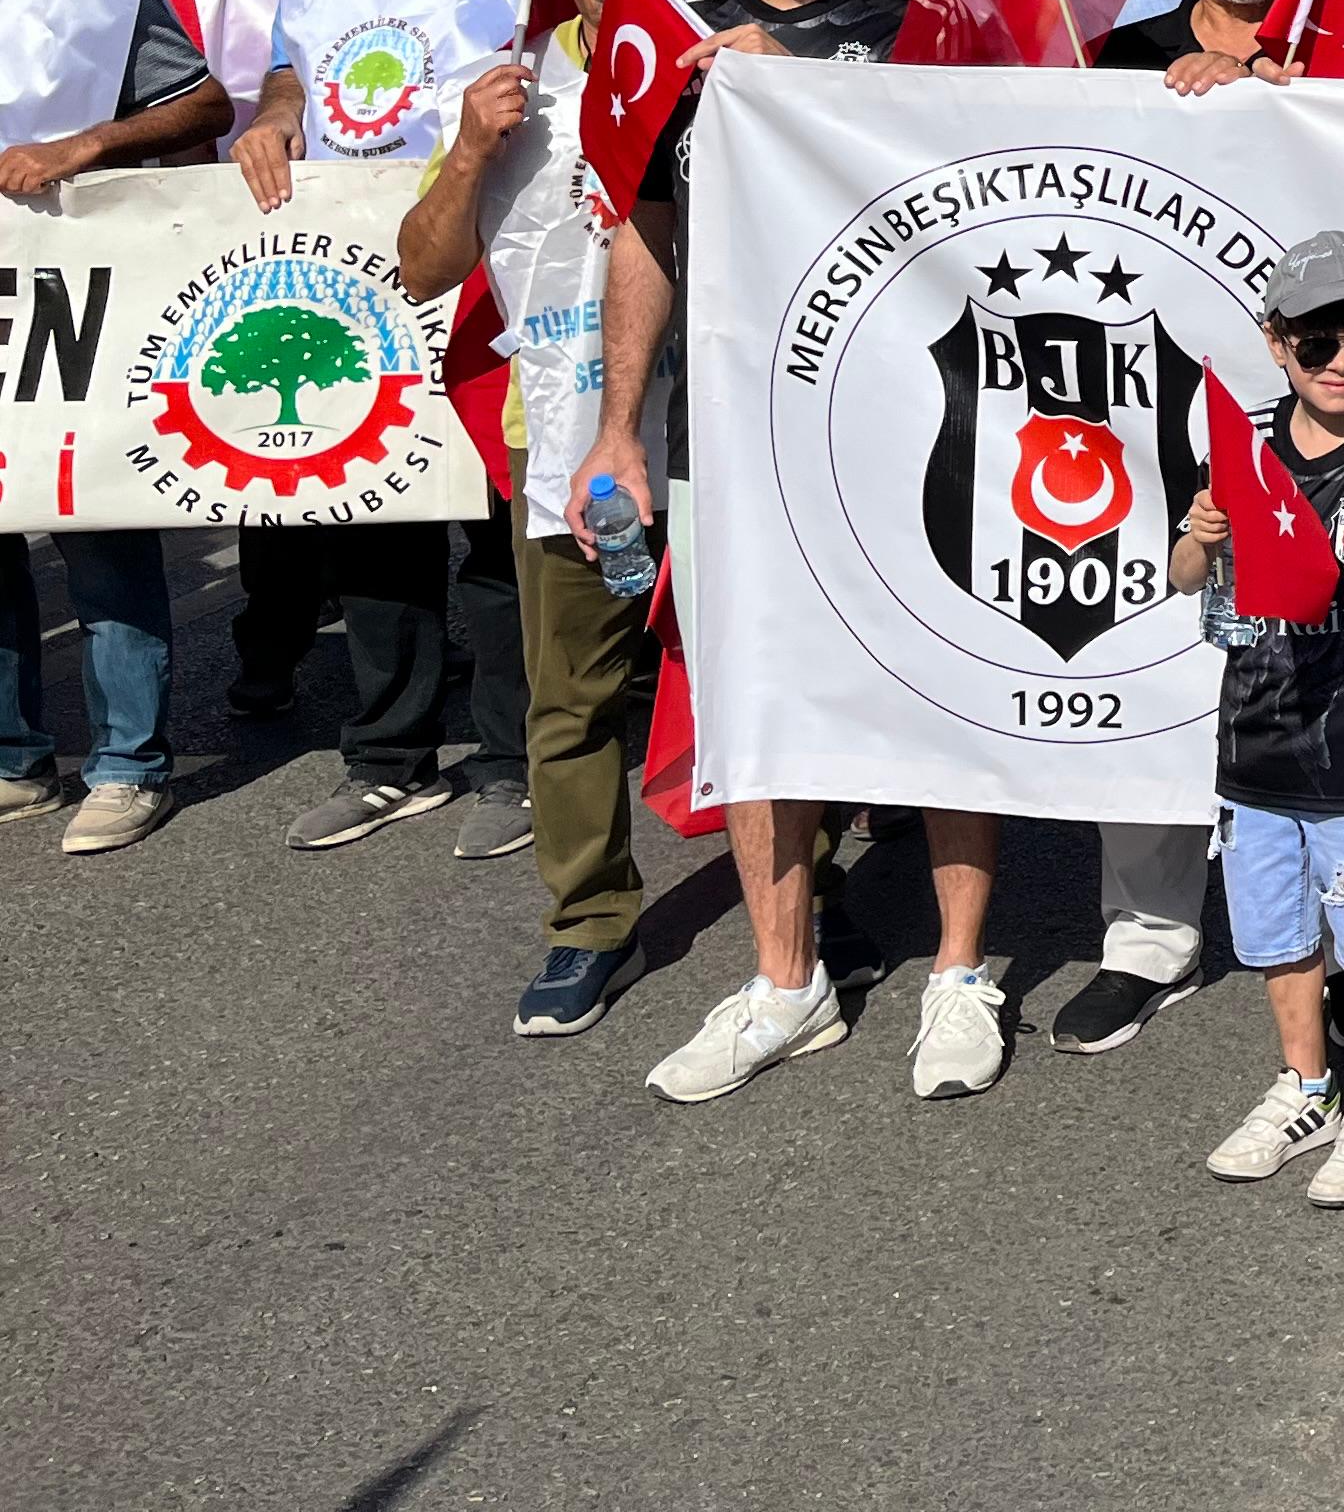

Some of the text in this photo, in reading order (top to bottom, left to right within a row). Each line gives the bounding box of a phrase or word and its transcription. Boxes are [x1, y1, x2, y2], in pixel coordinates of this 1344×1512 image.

[314, 53, 334, 84] TÜM
[332, 14, 407, 52] EMEKLİLER
[127, 332, 168, 408] TÜM
[160, 231, 333, 326] EMEKLİLER
[980, 326, 1154, 410] BJK
[257, 430, 314, 448] 2017
[125, 444, 283, 528] MERSİN
[989, 555, 1157, 607] 1903
[1010, 688, 1124, 730] 1992
